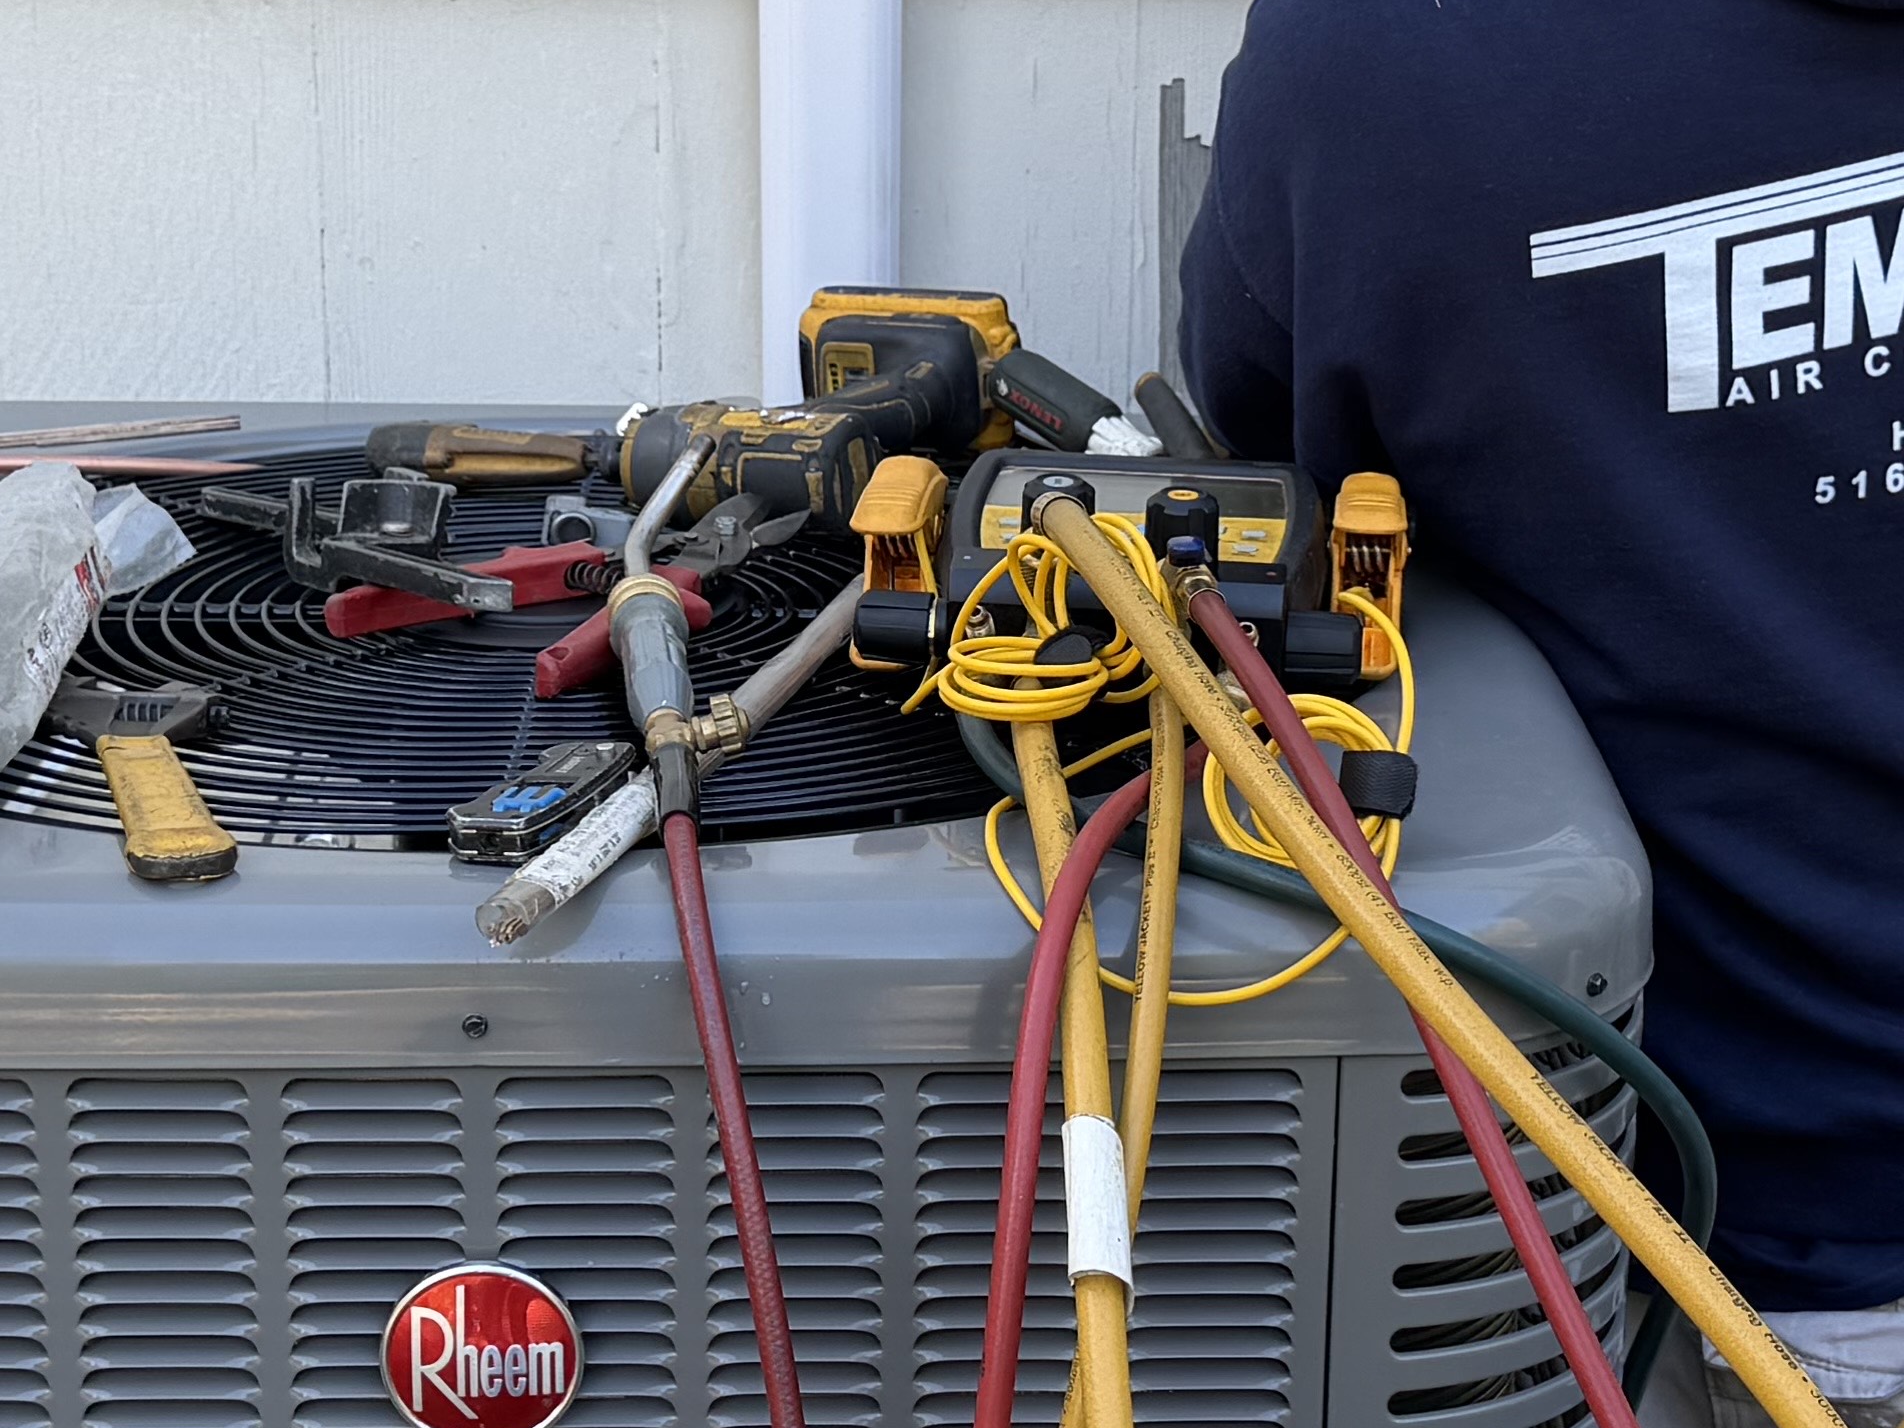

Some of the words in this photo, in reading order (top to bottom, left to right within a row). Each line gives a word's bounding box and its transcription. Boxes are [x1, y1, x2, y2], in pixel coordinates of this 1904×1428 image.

[1010, 389, 1064, 433] LENOX
[1724, 367, 1823, 407] AIR
[1131, 949, 1149, 1004] YELLOW
[410, 1284, 565, 1420] Rheem
